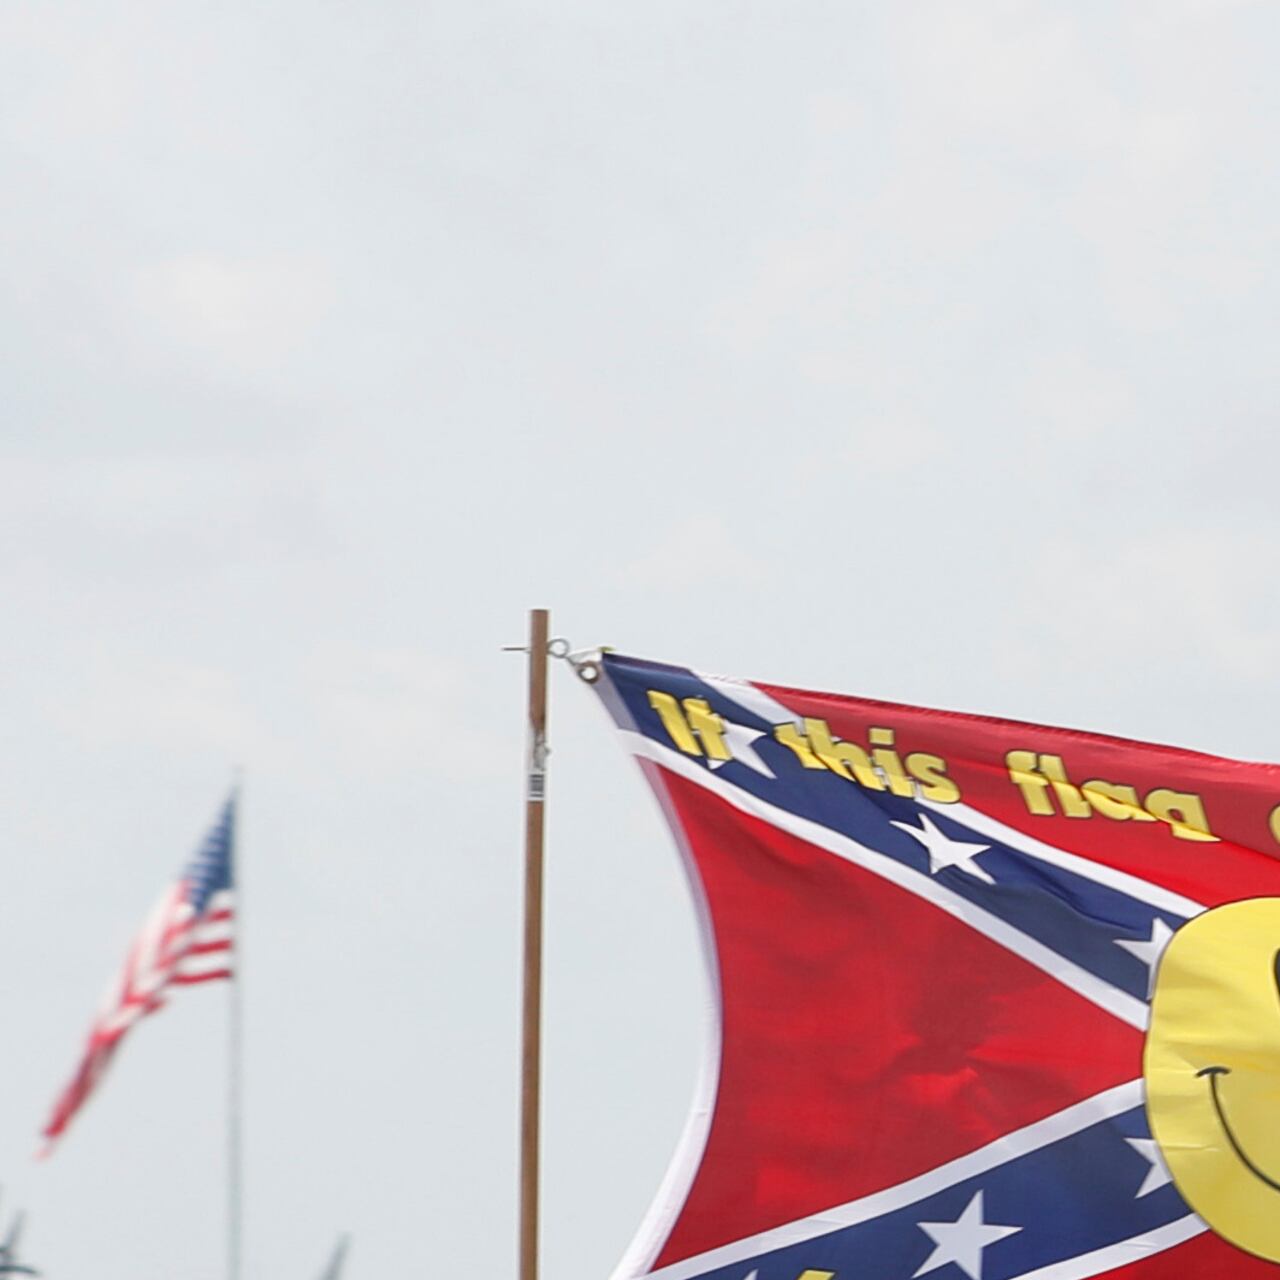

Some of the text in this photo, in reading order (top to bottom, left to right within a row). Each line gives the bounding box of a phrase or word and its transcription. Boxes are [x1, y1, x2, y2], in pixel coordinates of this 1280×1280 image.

[647, 689, 734, 761] If
[774, 716, 960, 804] this
[1004, 749, 1221, 842] flag
